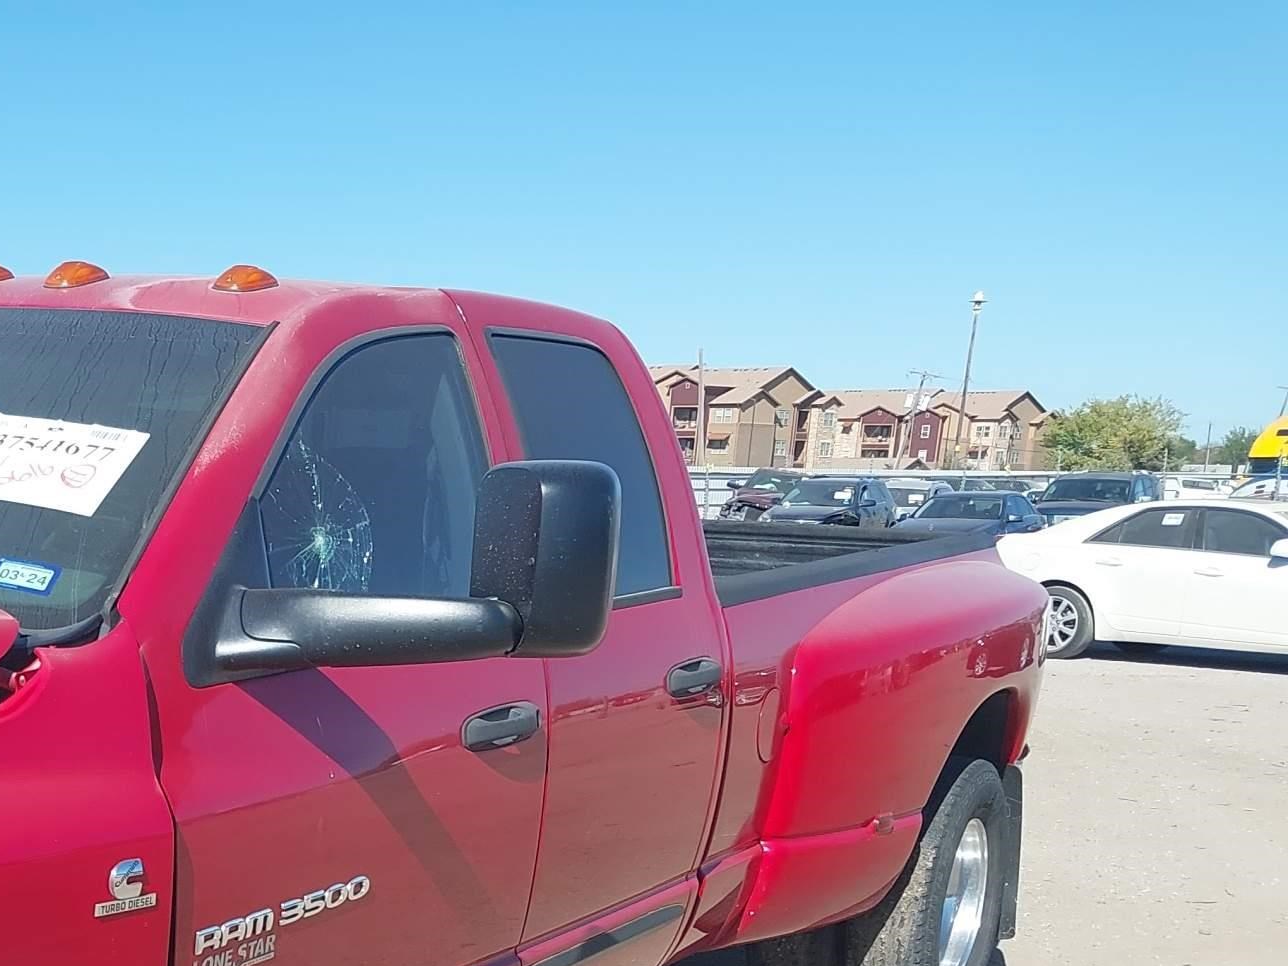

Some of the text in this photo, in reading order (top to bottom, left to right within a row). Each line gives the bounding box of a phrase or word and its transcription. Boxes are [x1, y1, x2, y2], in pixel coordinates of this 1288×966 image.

[100, 895, 153, 915] TURBO DIESEL
[195, 874, 371, 956] RAM 3500
[238, 933, 277, 962] STAR
